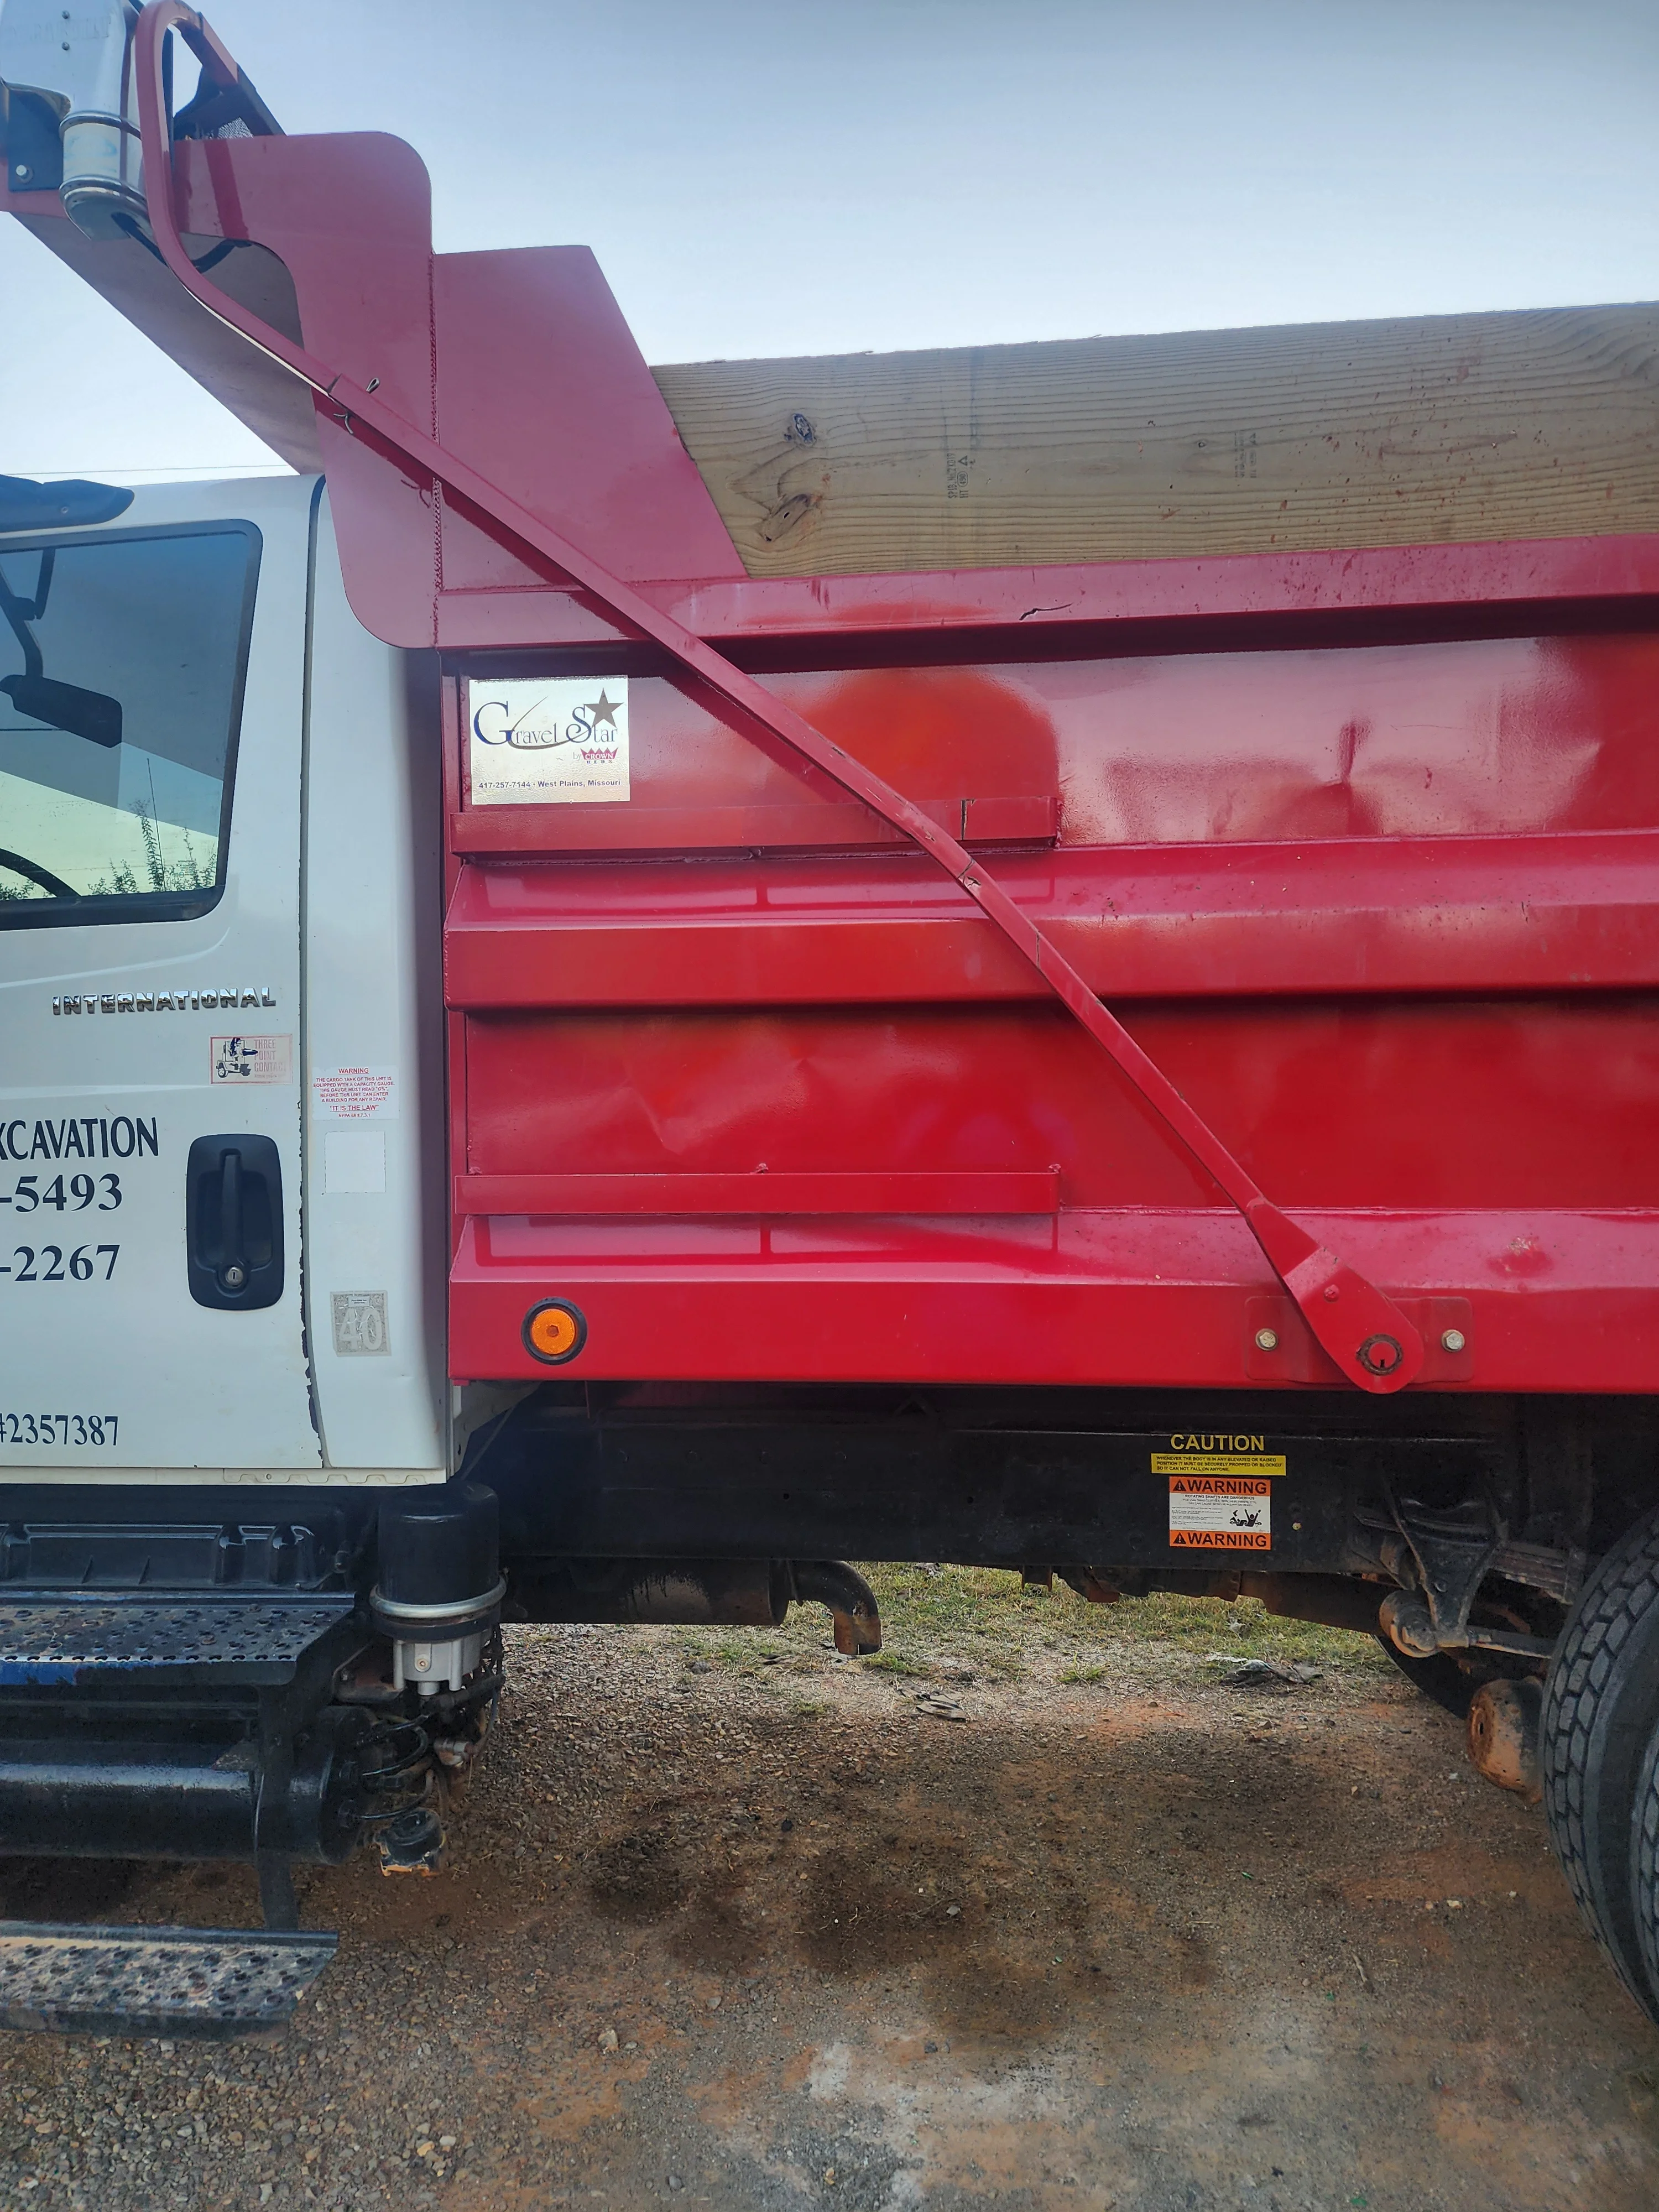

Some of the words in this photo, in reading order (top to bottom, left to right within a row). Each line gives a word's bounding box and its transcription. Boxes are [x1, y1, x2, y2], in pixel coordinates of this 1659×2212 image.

[959, 490, 969, 498] HT
[474, 700, 559, 745] Gravel
[566, 703, 618, 743] Star
[573, 752, 582, 761] by
[53, 987, 276, 1015] INTERNATIONAL
[254, 1039, 276, 1048] THREE
[254, 1050, 276, 1060] POINT
[339, 1307, 382, 1351] 40
[1171, 1434, 1265, 1451] CAUTION
[1187, 1479, 1267, 1494] WARNING
[1187, 1532, 1267, 1547] WARNING
